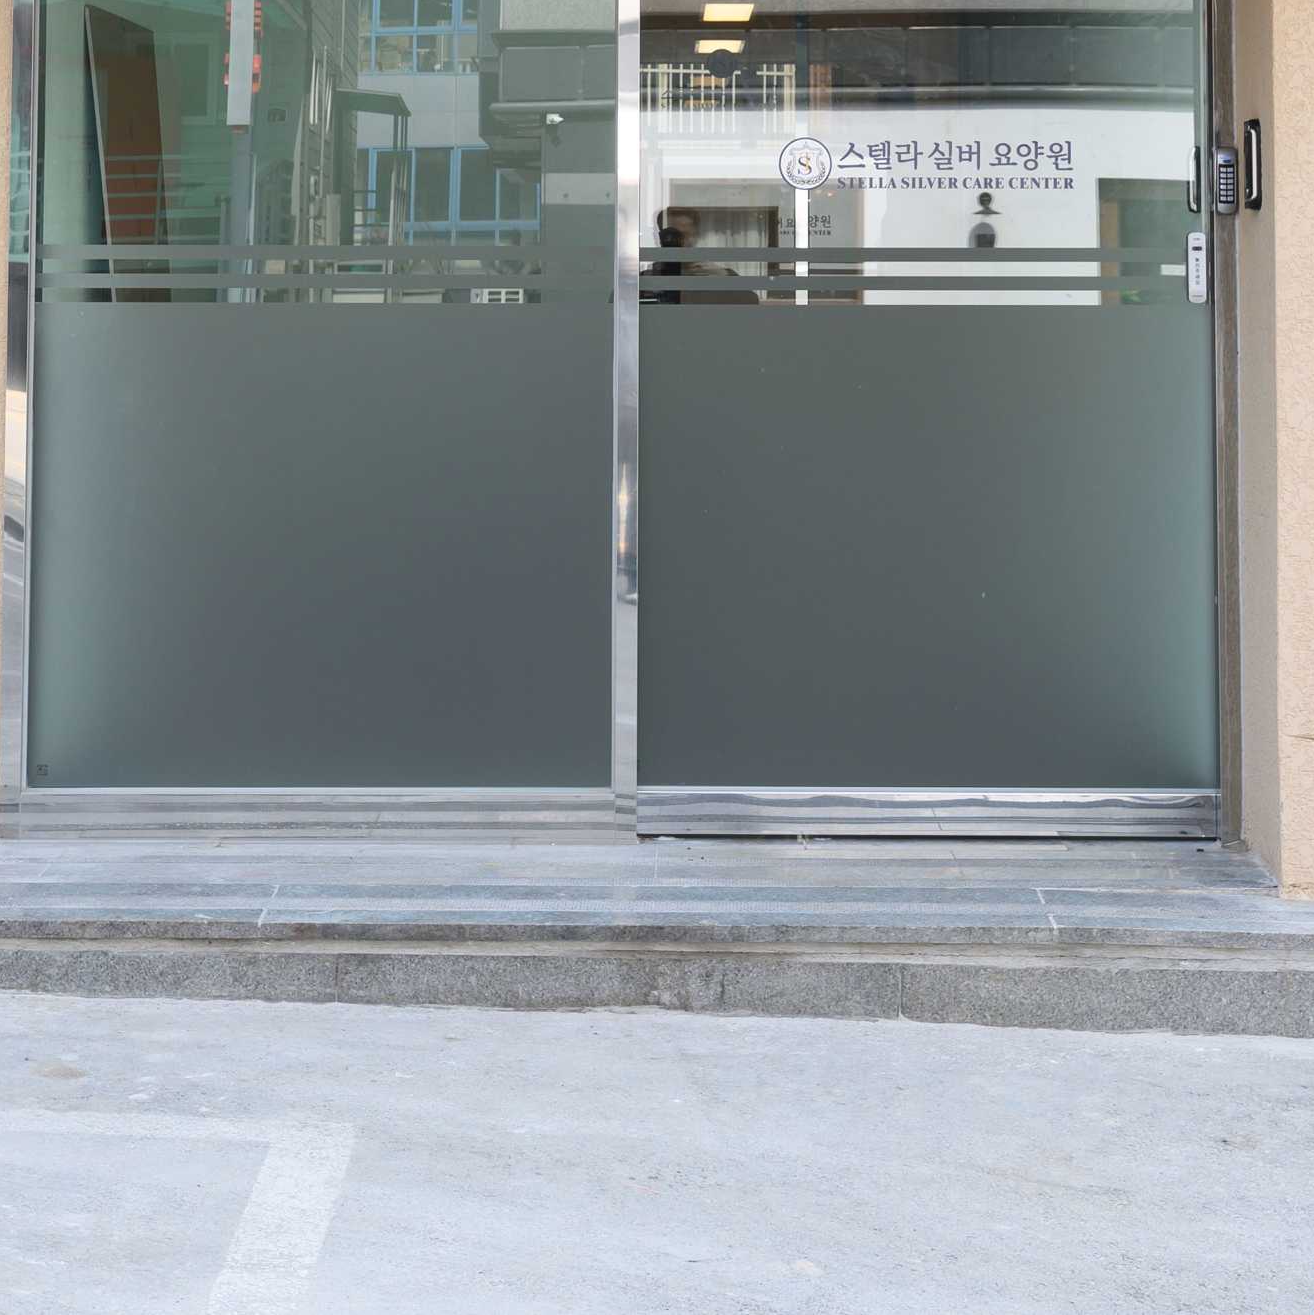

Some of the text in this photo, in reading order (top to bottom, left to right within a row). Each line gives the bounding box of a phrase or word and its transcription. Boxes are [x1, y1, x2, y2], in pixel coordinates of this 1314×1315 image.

[837, 140, 1074, 171] 스텔라 실버 요양원
[837, 177, 1074, 189] STELLA SILVER CARE CENTER
